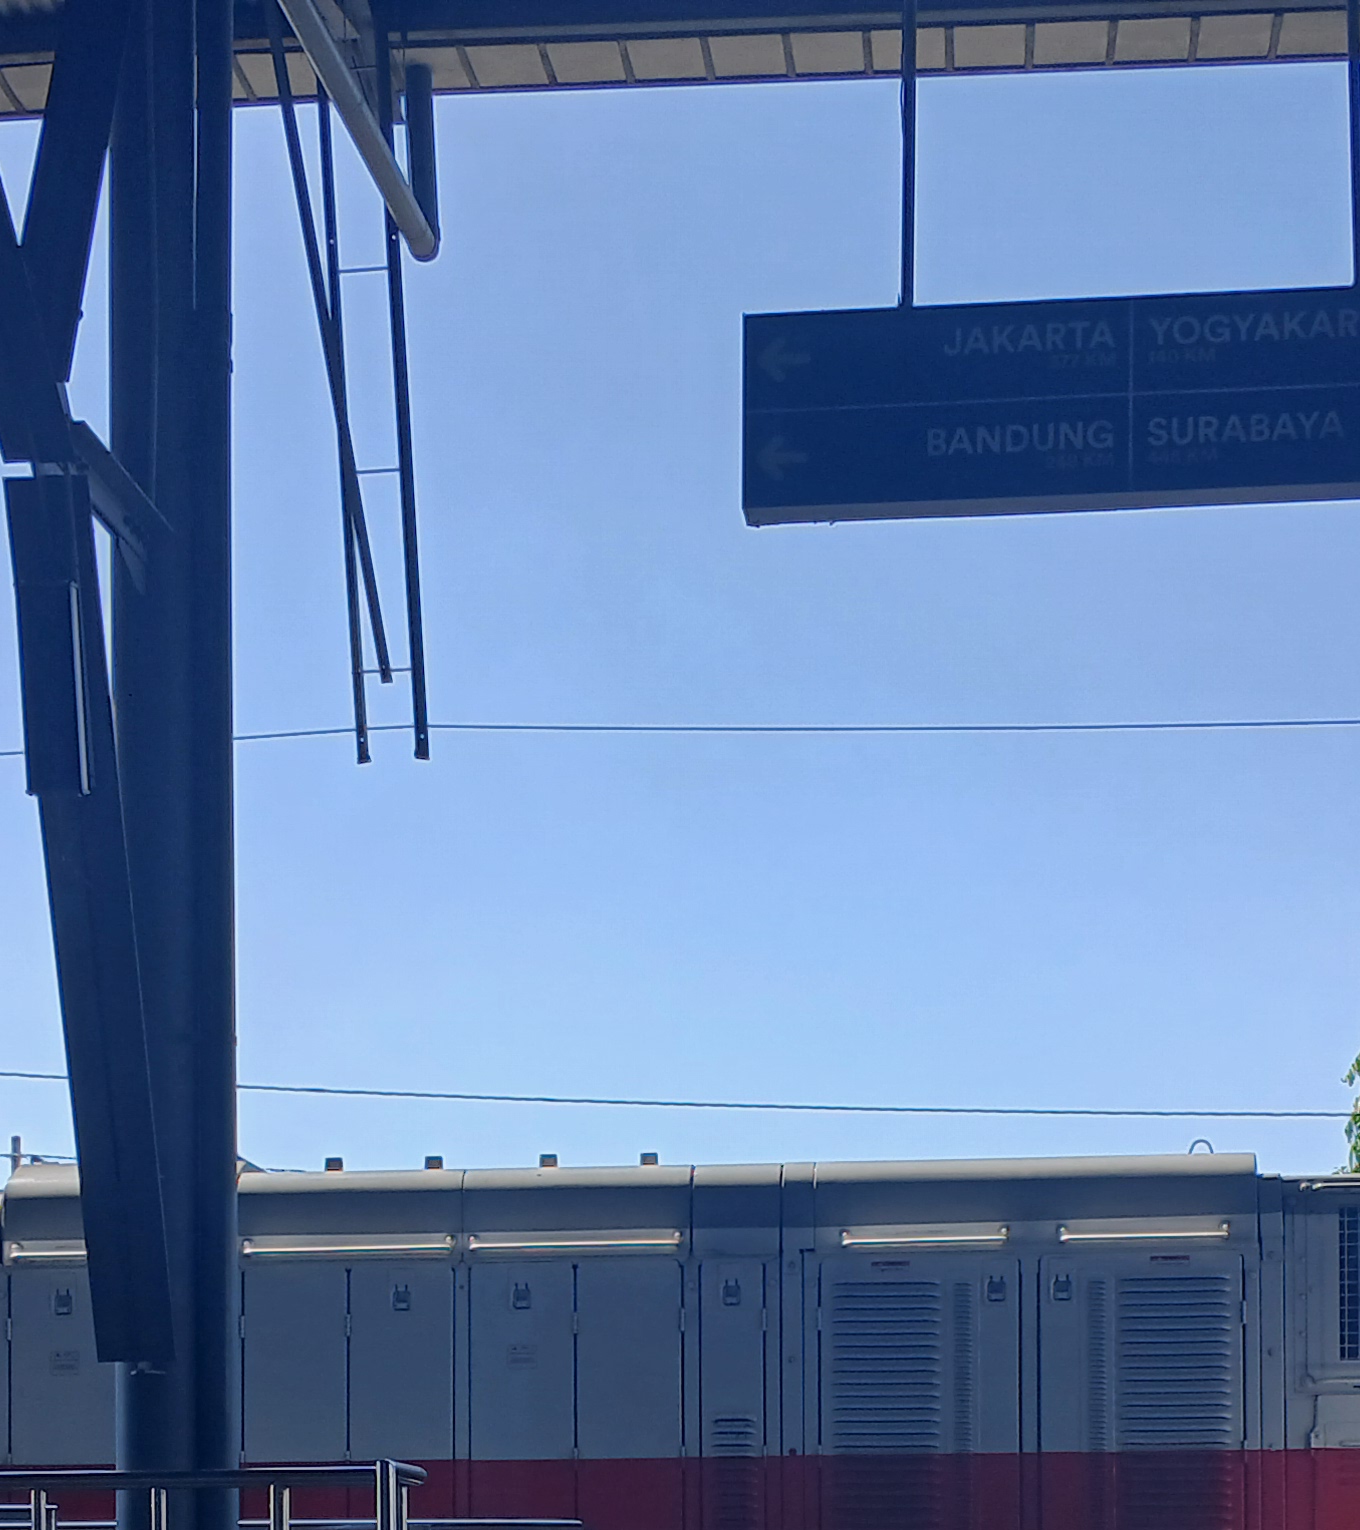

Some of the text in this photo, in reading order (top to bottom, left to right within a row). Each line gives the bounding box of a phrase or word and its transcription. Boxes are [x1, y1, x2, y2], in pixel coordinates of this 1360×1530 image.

[943, 320, 1115, 356] JAKARTA
[1184, 346, 1217, 362] KM
[1084, 351, 1117, 367] KM
[926, 420, 1115, 457] BANDUNG
[1146, 409, 1346, 447] SURABAYA
